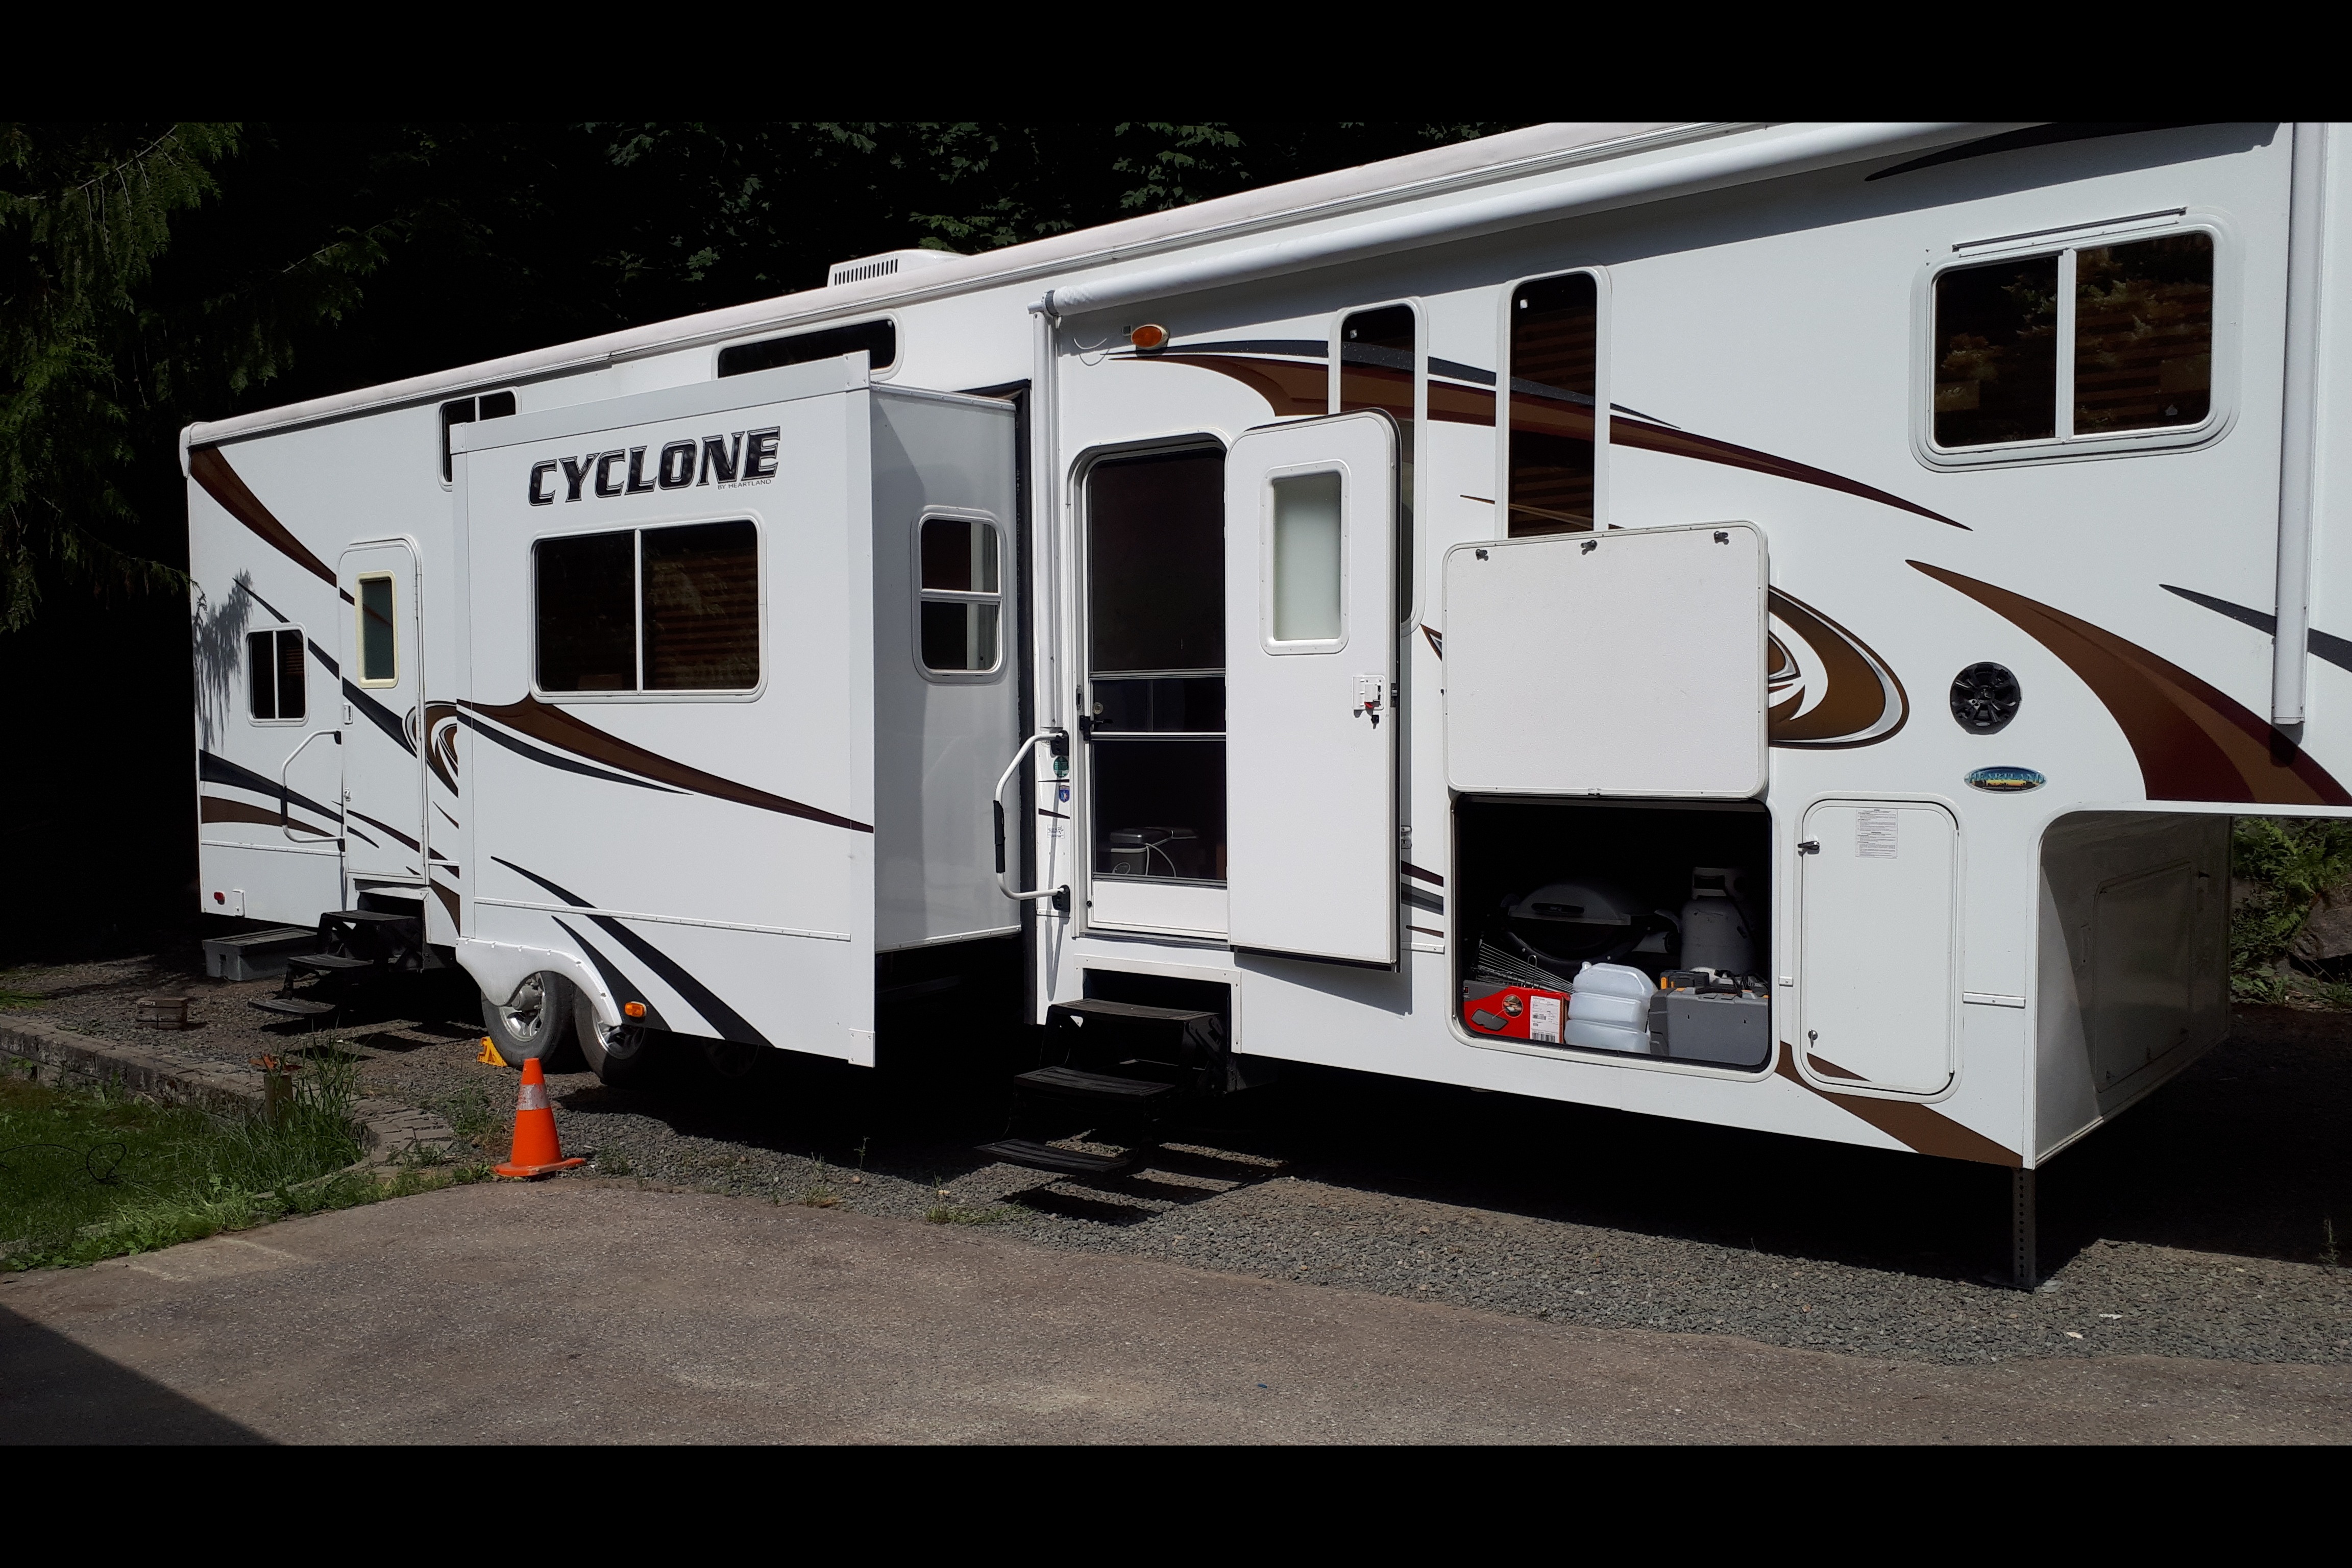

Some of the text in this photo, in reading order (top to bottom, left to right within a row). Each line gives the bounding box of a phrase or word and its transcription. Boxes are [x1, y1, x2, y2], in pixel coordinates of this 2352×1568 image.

[528, 426, 781, 507] CYCLONE
[728, 479, 771, 488] HEARTLAND
[1968, 771, 2046, 784] HEARTLAND
